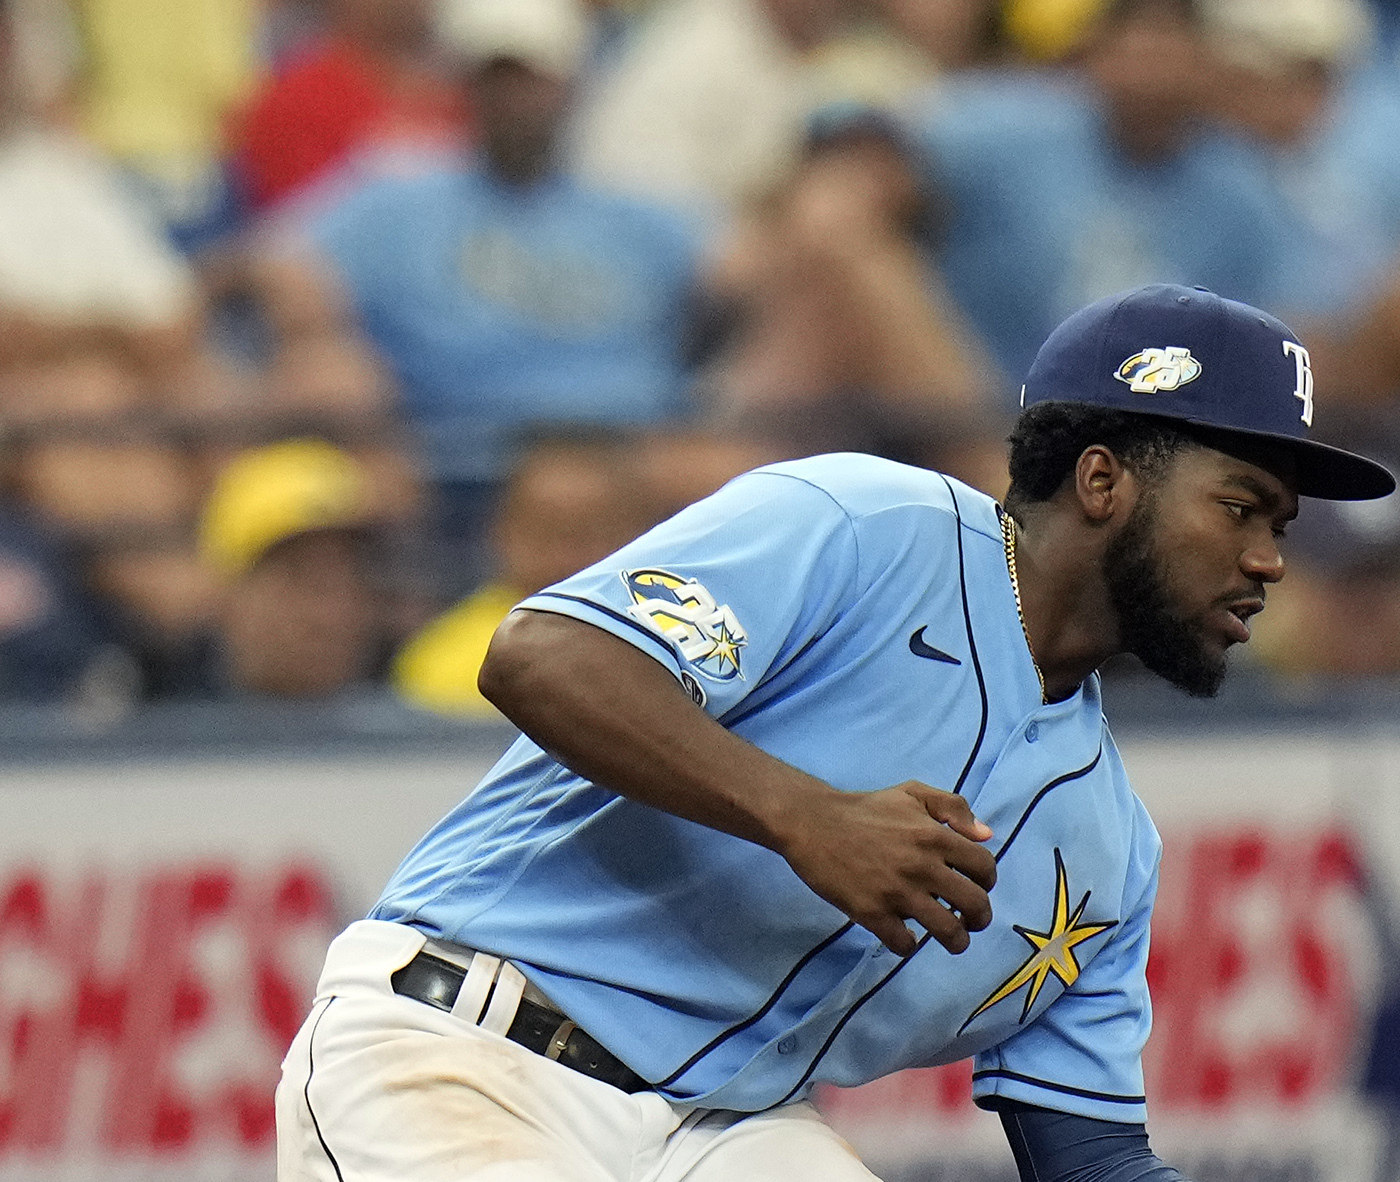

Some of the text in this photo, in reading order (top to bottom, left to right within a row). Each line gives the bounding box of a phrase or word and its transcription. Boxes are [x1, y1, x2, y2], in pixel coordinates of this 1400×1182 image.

[1130, 346, 1191, 393] 25
[1282, 340, 1314, 427] TB
[627, 576, 749, 662] 25
